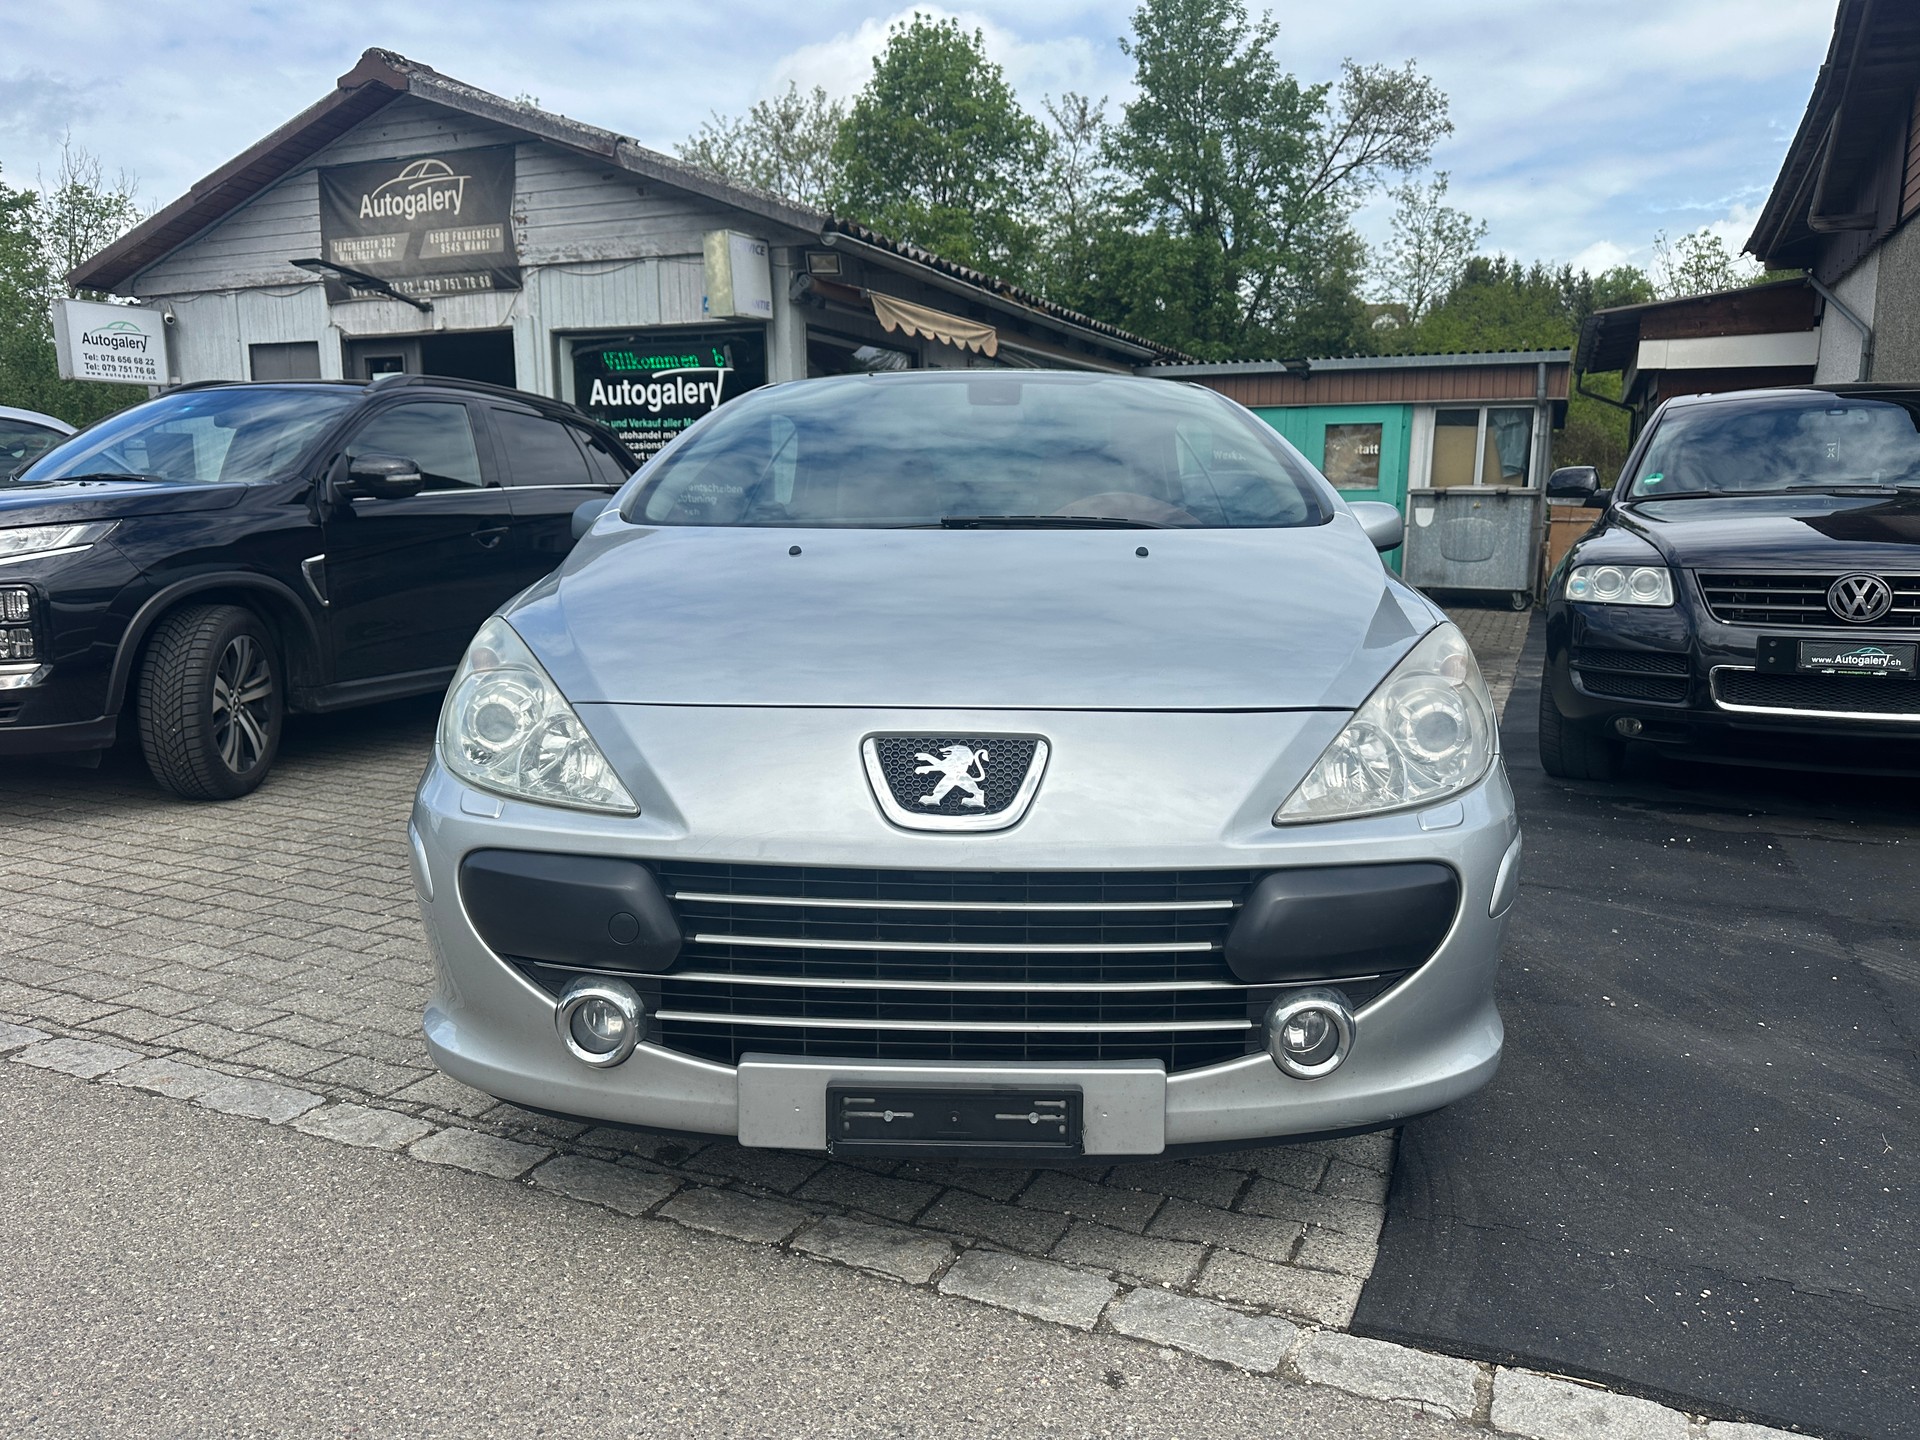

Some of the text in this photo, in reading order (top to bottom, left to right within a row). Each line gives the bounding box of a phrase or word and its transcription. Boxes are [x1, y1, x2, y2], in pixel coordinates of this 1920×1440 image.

[359, 177, 465, 220] Autogalery
[452, 227, 500, 241] FRAUENFELD
[403, 281, 414, 293] 22
[444, 277, 461, 290] 751
[464, 276, 476, 289] 76
[479, 275, 491, 288] 68
[82, 332, 148, 353] Autogalery
[83, 353, 98, 361] Tel:
[101, 353, 116, 363] 078
[145, 358, 155, 366] 22
[84, 362, 99, 370] Tel:
[102, 364, 117, 372] 079
[119, 365, 133, 373] 751
[135, 366, 145, 375] 76
[589, 371, 724, 413] Autogalery
[611, 419, 627, 428] und
[629, 418, 661, 428] Verkauf
[663, 418, 681, 427] aller
[618, 430, 661, 440] utohandel
[1811, 653, 1902, 667] www.Autogalery.ch
